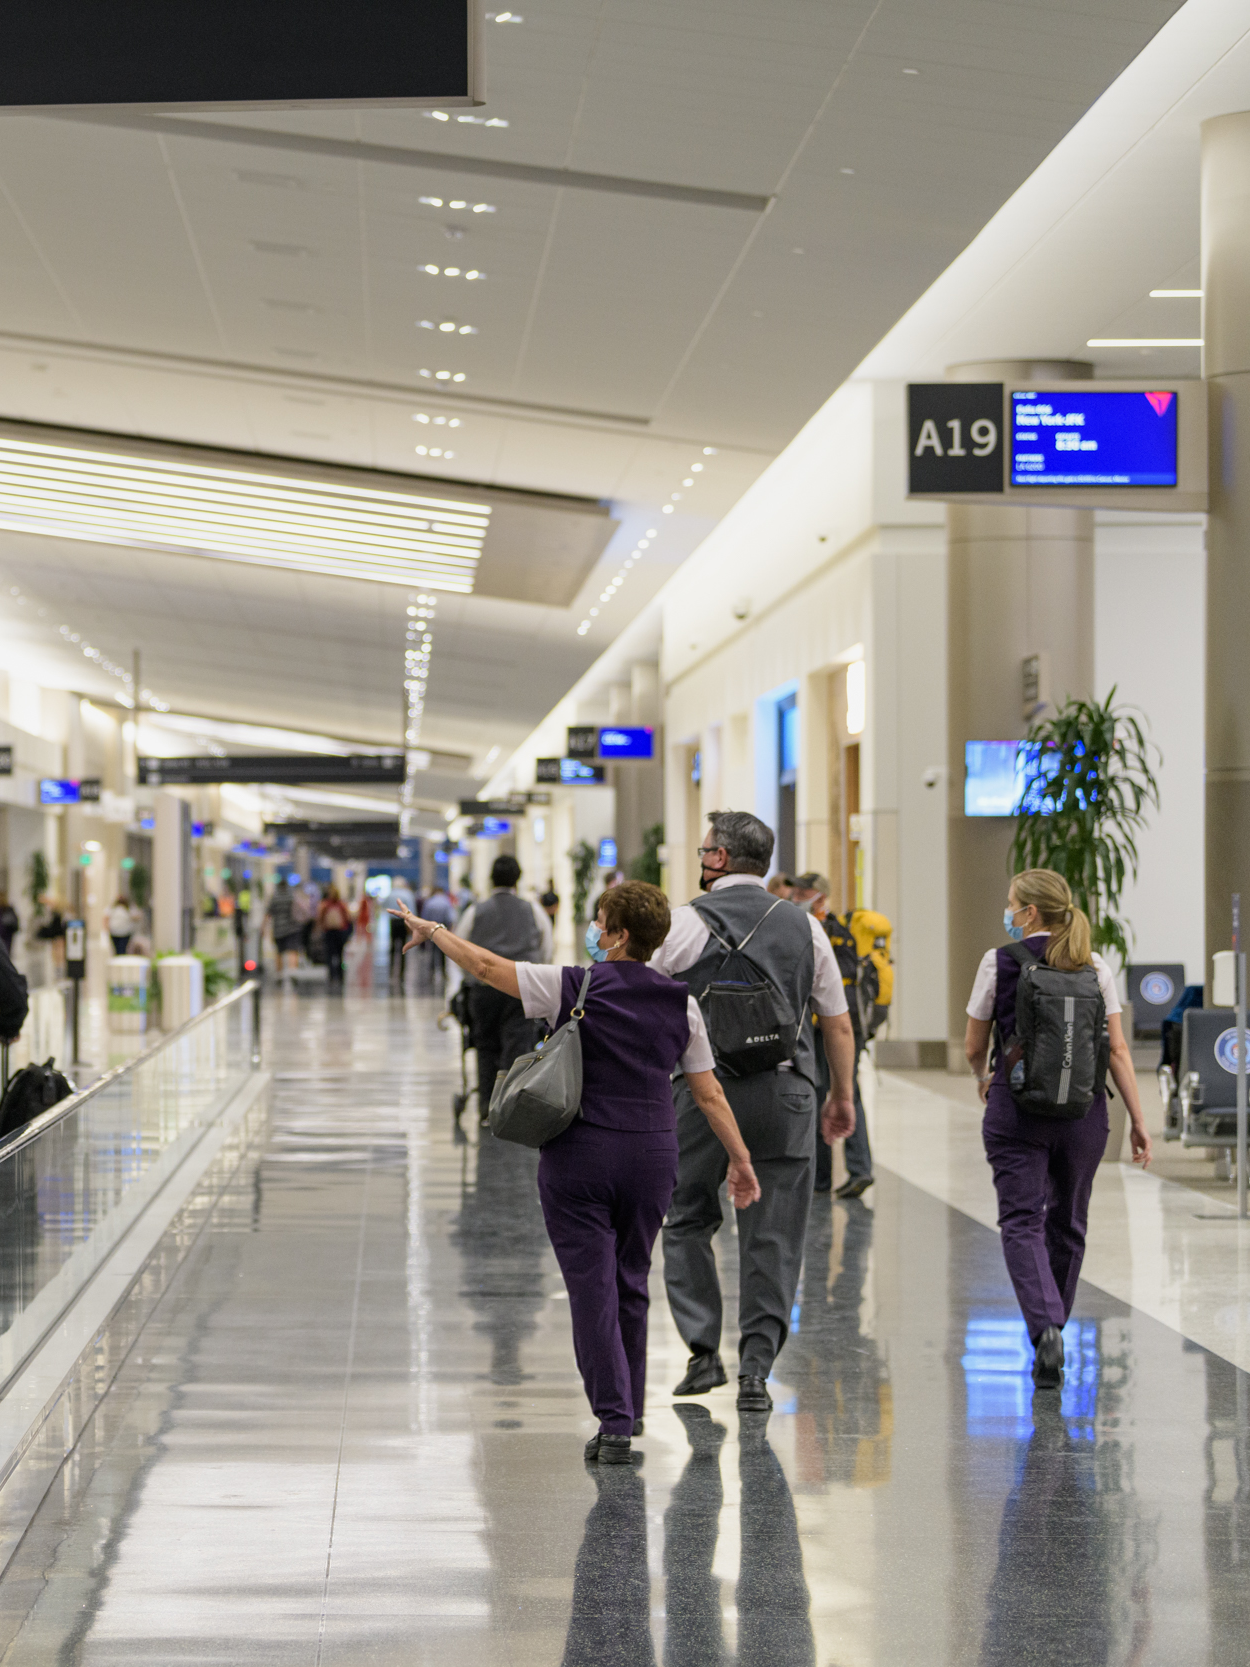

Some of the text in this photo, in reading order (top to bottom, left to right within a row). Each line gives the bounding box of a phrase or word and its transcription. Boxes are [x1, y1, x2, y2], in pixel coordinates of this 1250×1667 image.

[914, 418, 998, 457] A19
[753, 1033, 780, 1042] DELTA
[1062, 1022, 1073, 1068] Calvin Klein
